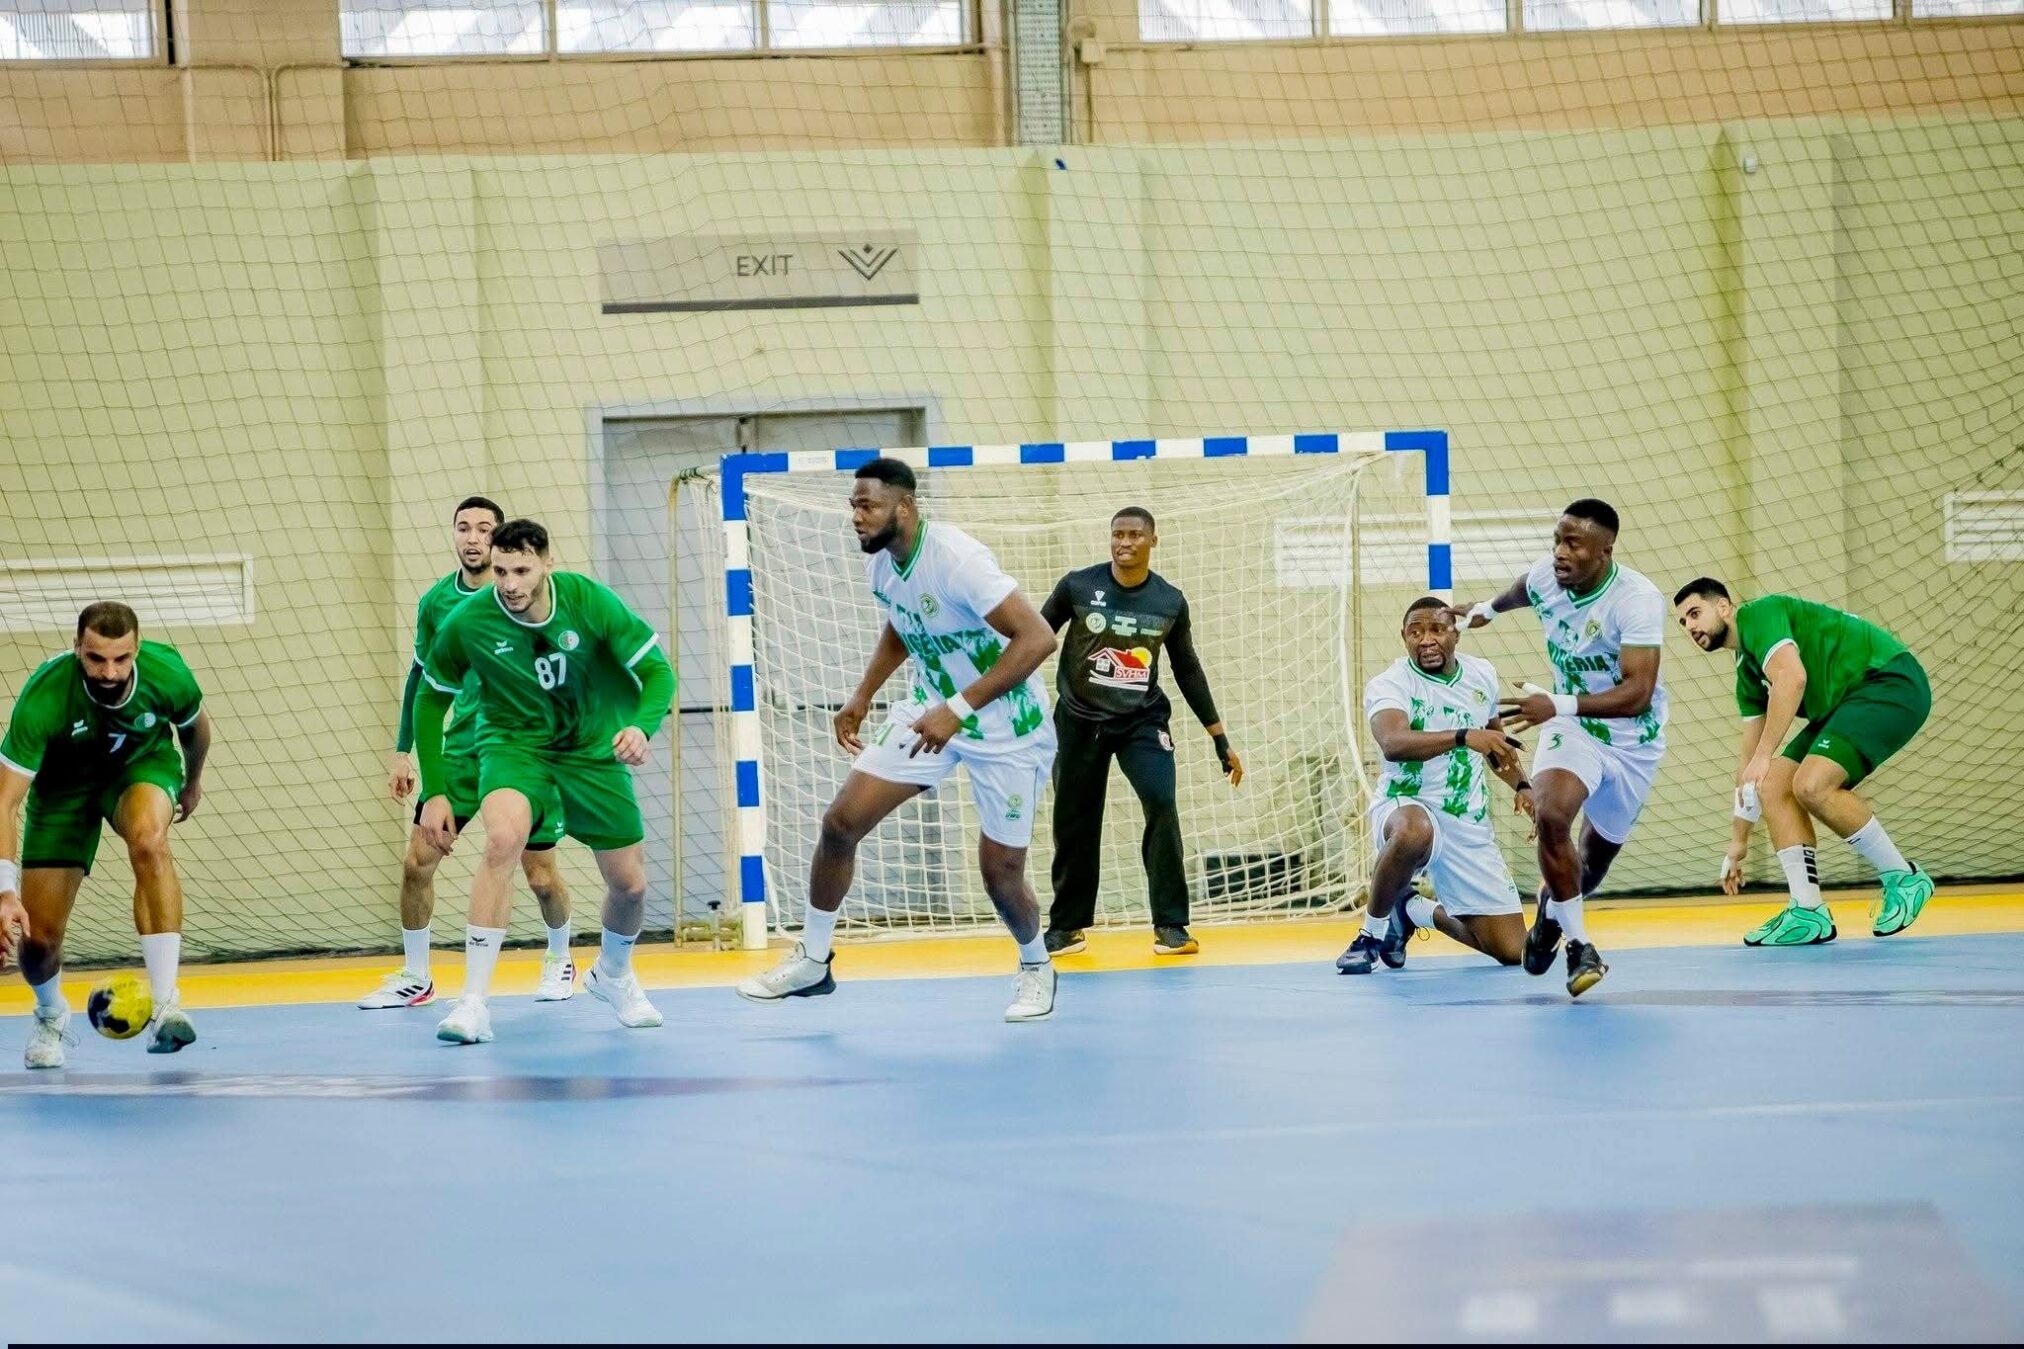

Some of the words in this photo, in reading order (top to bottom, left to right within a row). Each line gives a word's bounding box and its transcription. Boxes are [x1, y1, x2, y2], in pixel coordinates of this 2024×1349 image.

[737, 254, 793, 276] EXIT
[534, 652, 567, 691] 87
[108, 732, 127, 753] 7
